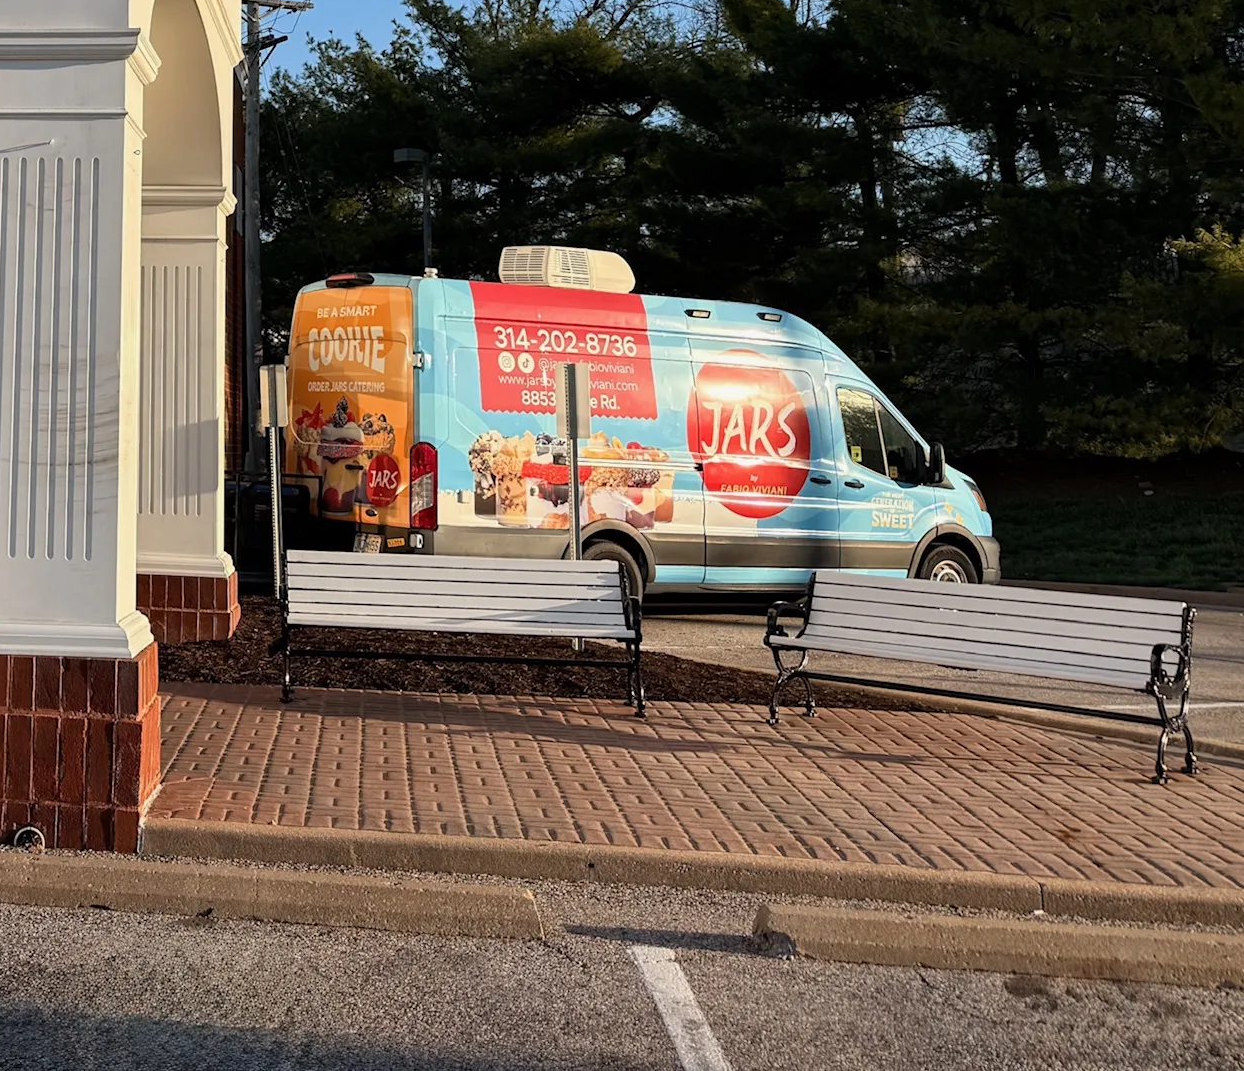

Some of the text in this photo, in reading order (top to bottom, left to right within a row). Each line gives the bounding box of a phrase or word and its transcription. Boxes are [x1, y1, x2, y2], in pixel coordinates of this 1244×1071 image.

[317, 305, 377, 318] BE A SMART
[308, 325, 385, 374] COOKIE
[494, 326, 637, 357] 314-202-8736
[308, 381, 385, 393] ORDER JARS CATERING
[522, 390, 556, 406] 8853
[600, 395, 621, 410] Rd.
[701, 399, 796, 458] JARS
[369, 470, 398, 489] JARS
[750, 474, 758, 483] by
[721, 484, 787, 495] FABIO VIVIANI
[872, 510, 914, 529] SWEET
